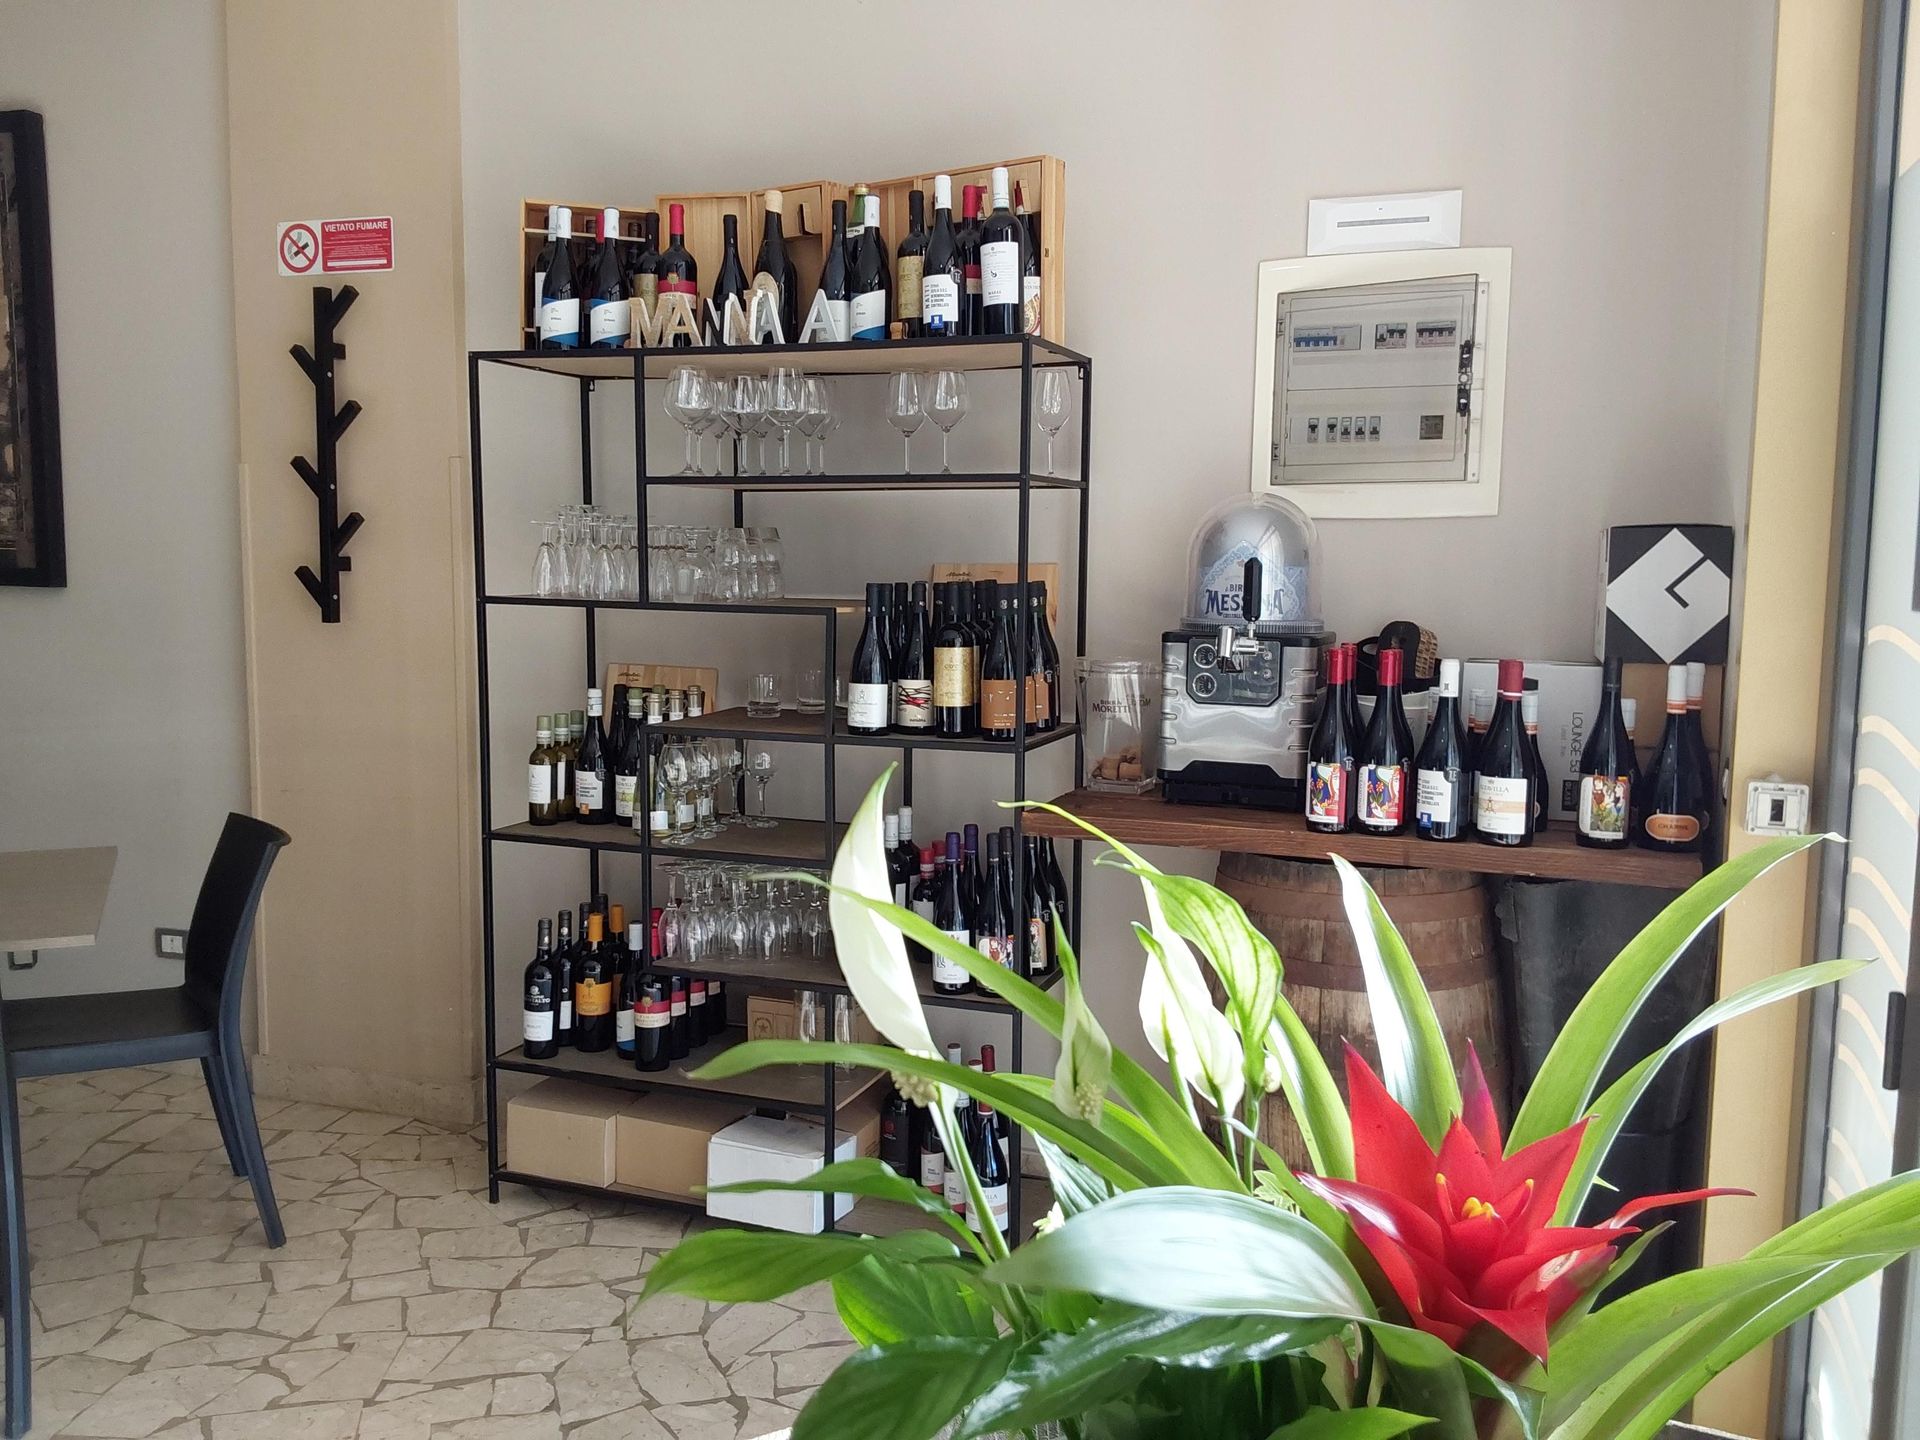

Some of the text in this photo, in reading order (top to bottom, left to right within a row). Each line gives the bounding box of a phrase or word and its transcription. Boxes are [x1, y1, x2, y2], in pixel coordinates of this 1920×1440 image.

[324, 221, 388, 232] VIETATO FUMARE
[1205, 588, 1284, 616] MESA
[1569, 711, 1584, 774] LOUNGE 53
